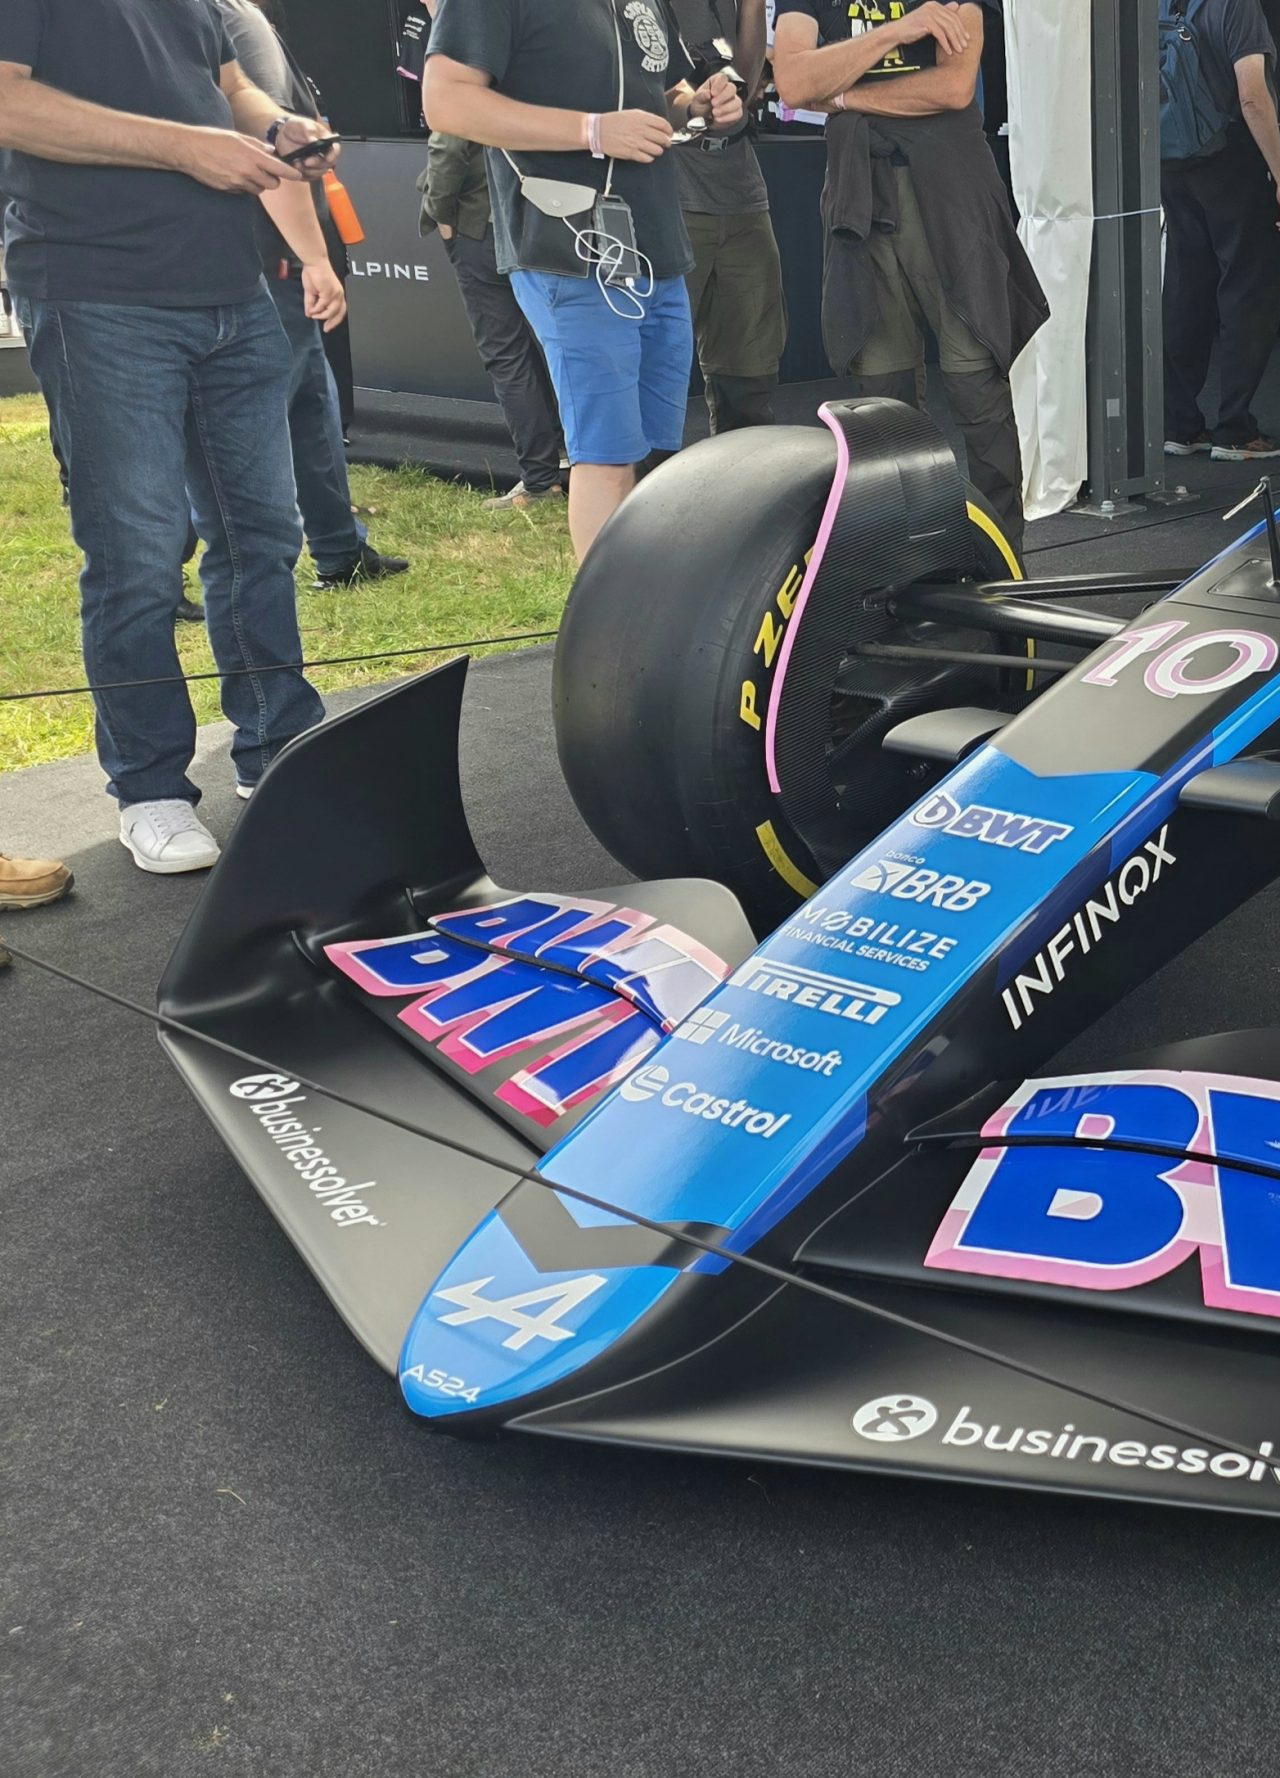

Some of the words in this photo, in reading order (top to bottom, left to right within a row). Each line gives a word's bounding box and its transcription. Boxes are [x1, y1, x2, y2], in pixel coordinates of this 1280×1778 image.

[351, 260, 429, 281] LPINE
[740, 680, 761, 731] P
[754, 543, 816, 668] ZE
[1080, 620, 1279, 698] 10
[943, 804, 1074, 854] BWT
[884, 850, 926, 865] banco
[890, 868, 992, 912] BRB
[781, 925, 856, 954] FINANCIAL
[855, 945, 931, 972] SERVICES
[726, 956, 902, 1025] PIRELLI
[718, 1023, 843, 1077] Microsoft
[661, 1081, 792, 1139] Castrol
[250, 1096, 379, 1228] businessolver
[403, 1363, 481, 1404] A524
